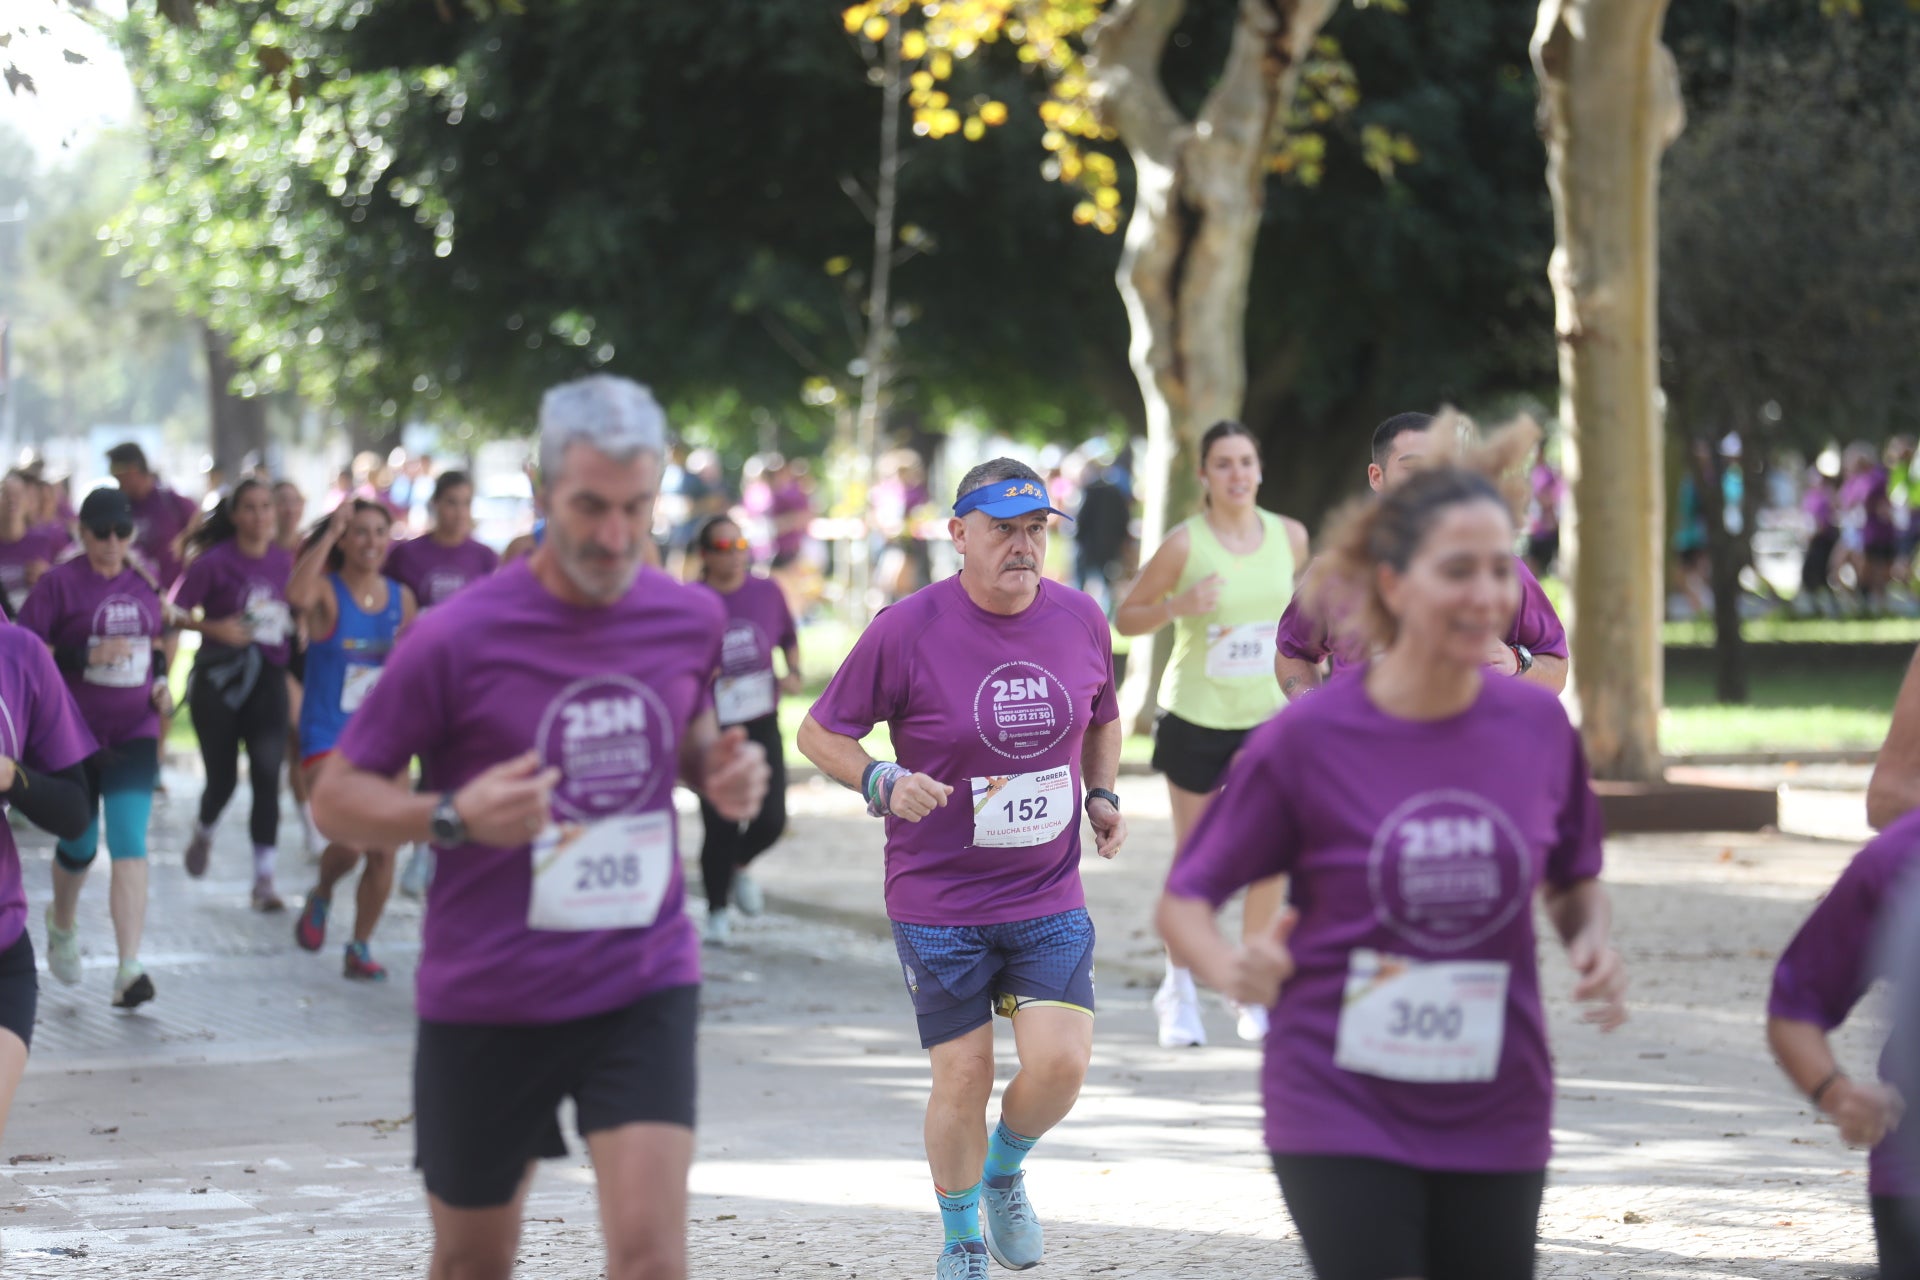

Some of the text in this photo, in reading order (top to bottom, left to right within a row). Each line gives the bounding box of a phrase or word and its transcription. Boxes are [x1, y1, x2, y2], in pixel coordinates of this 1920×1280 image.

[990, 663, 1010, 675] CONTRA
[1018, 660, 1044, 671] VIOLENCIA
[1057, 681, 1065, 691] LAS
[991, 676, 1049, 702] 25N
[562, 697, 646, 738] 25N
[998, 711, 1050, 723] 900 21 21 30
[991, 746, 1011, 758] CONTRA
[1020, 747, 1049, 760] VIOLENCIA
[1035, 770, 1068, 783] CARRERA
[1003, 796, 1048, 823] 152
[997, 828, 1021, 836] LUCHA
[1040, 820, 1062, 830] LUCHA
[1401, 816, 1494, 858] 25N
[575, 853, 641, 891] 208
[1387, 999, 1463, 1041] 300
